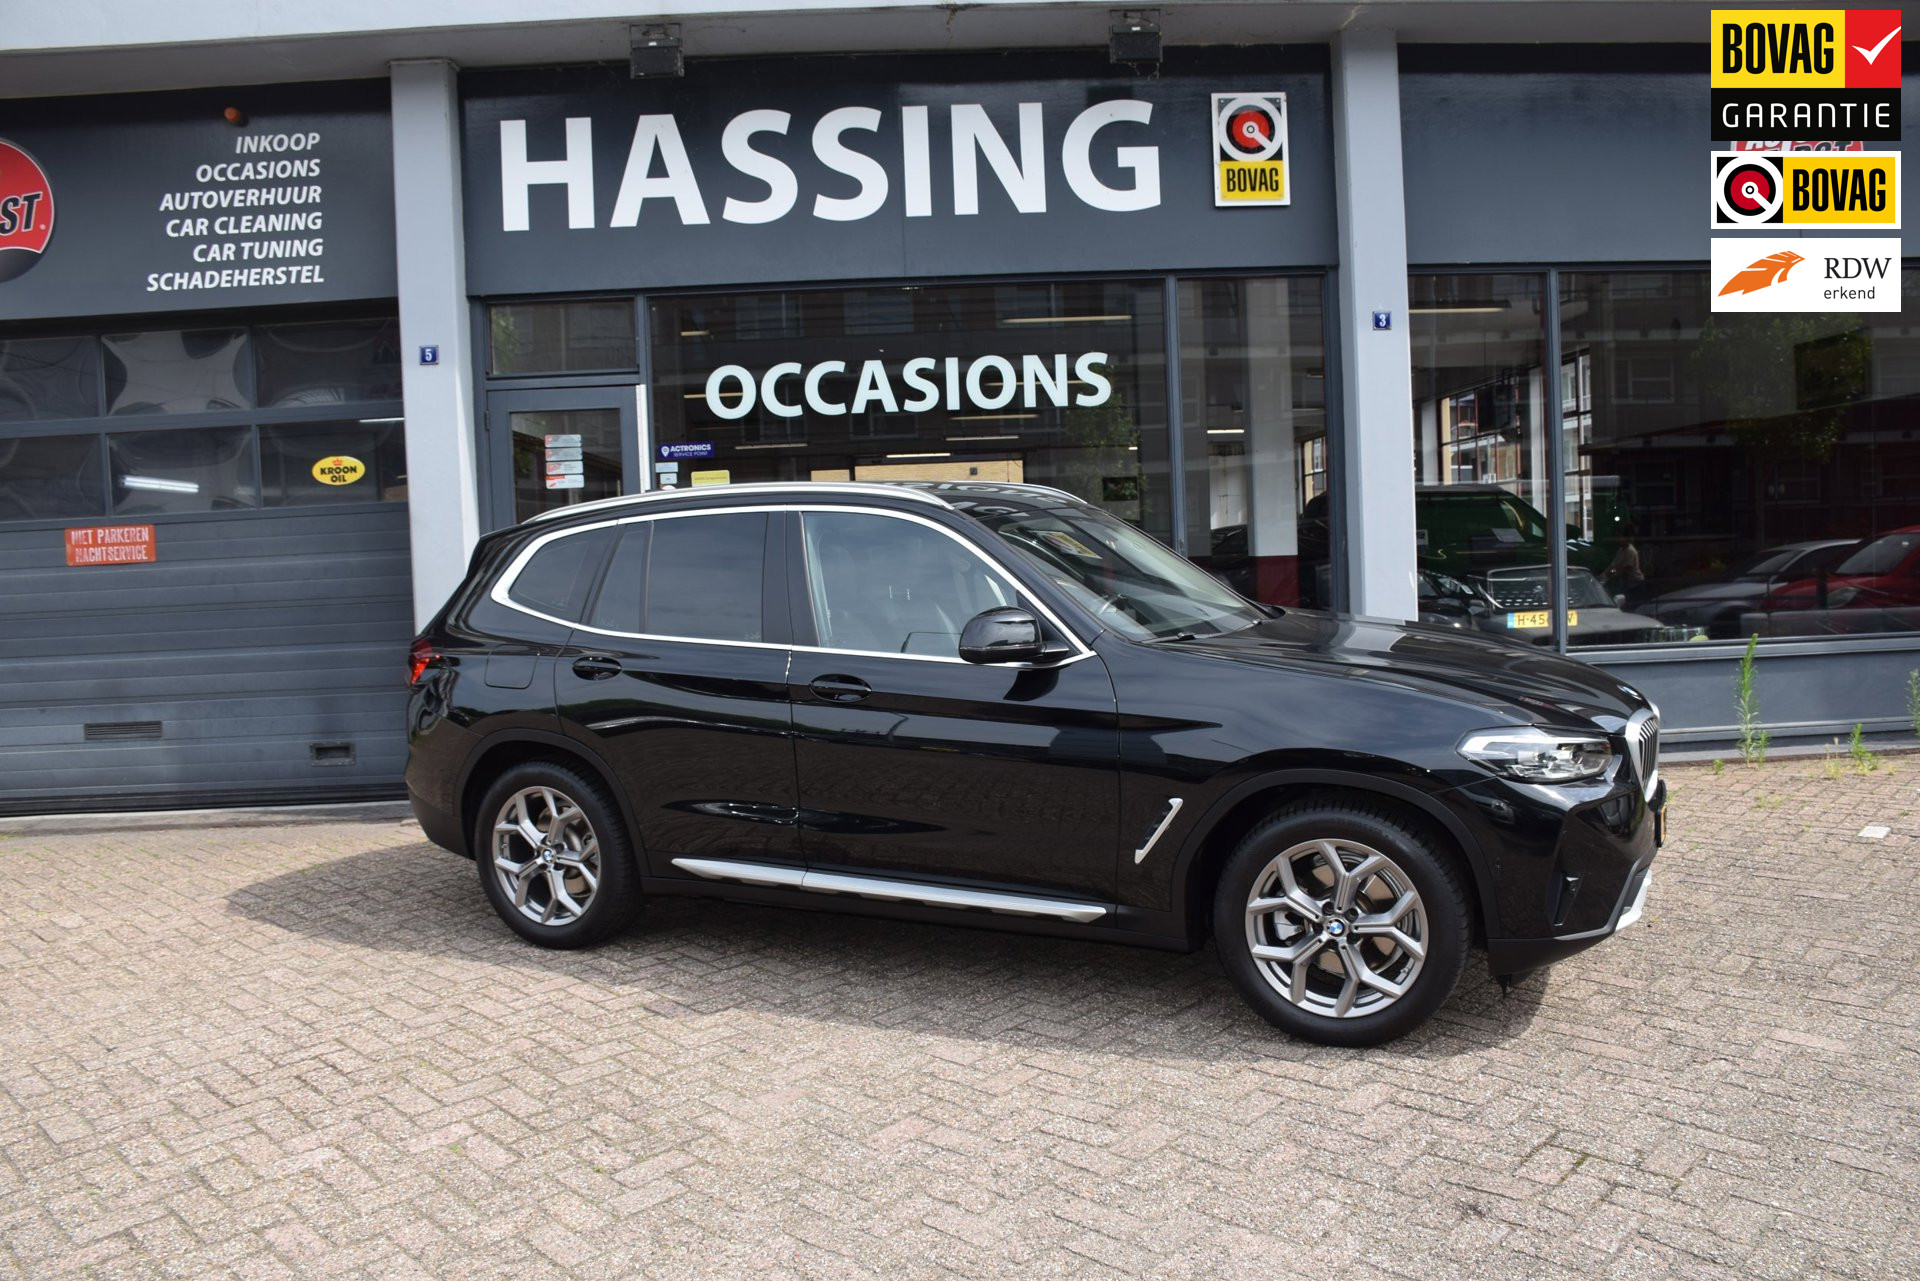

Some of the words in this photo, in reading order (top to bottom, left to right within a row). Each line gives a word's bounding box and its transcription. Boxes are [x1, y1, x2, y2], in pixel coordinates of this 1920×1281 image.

[235, 132, 321, 154] INKOOP
[195, 158, 321, 182] OCCASIONS
[500, 99, 1161, 232] HASSING
[1226, 167, 1279, 192] BOVAG
[159, 185, 322, 211] AUTOVERHUUR
[166, 218, 209, 237] CAR
[214, 212, 323, 234] CLEANING
[193, 243, 236, 262] CAR
[240, 238, 324, 260] TUNING
[146, 265, 325, 291] SCHADEHERSTEL
[1379, 313, 1386, 327] 3
[425, 348, 433, 361] 5
[705, 352, 1112, 420] OCCASIONS
[670, 444, 711, 452] ACTRONICS
[320, 466, 357, 475] KROON
[71, 530, 93, 545] NIET
[97, 527, 149, 544] PARKEREN
[75, 545, 148, 562] NACHTSERVICE
